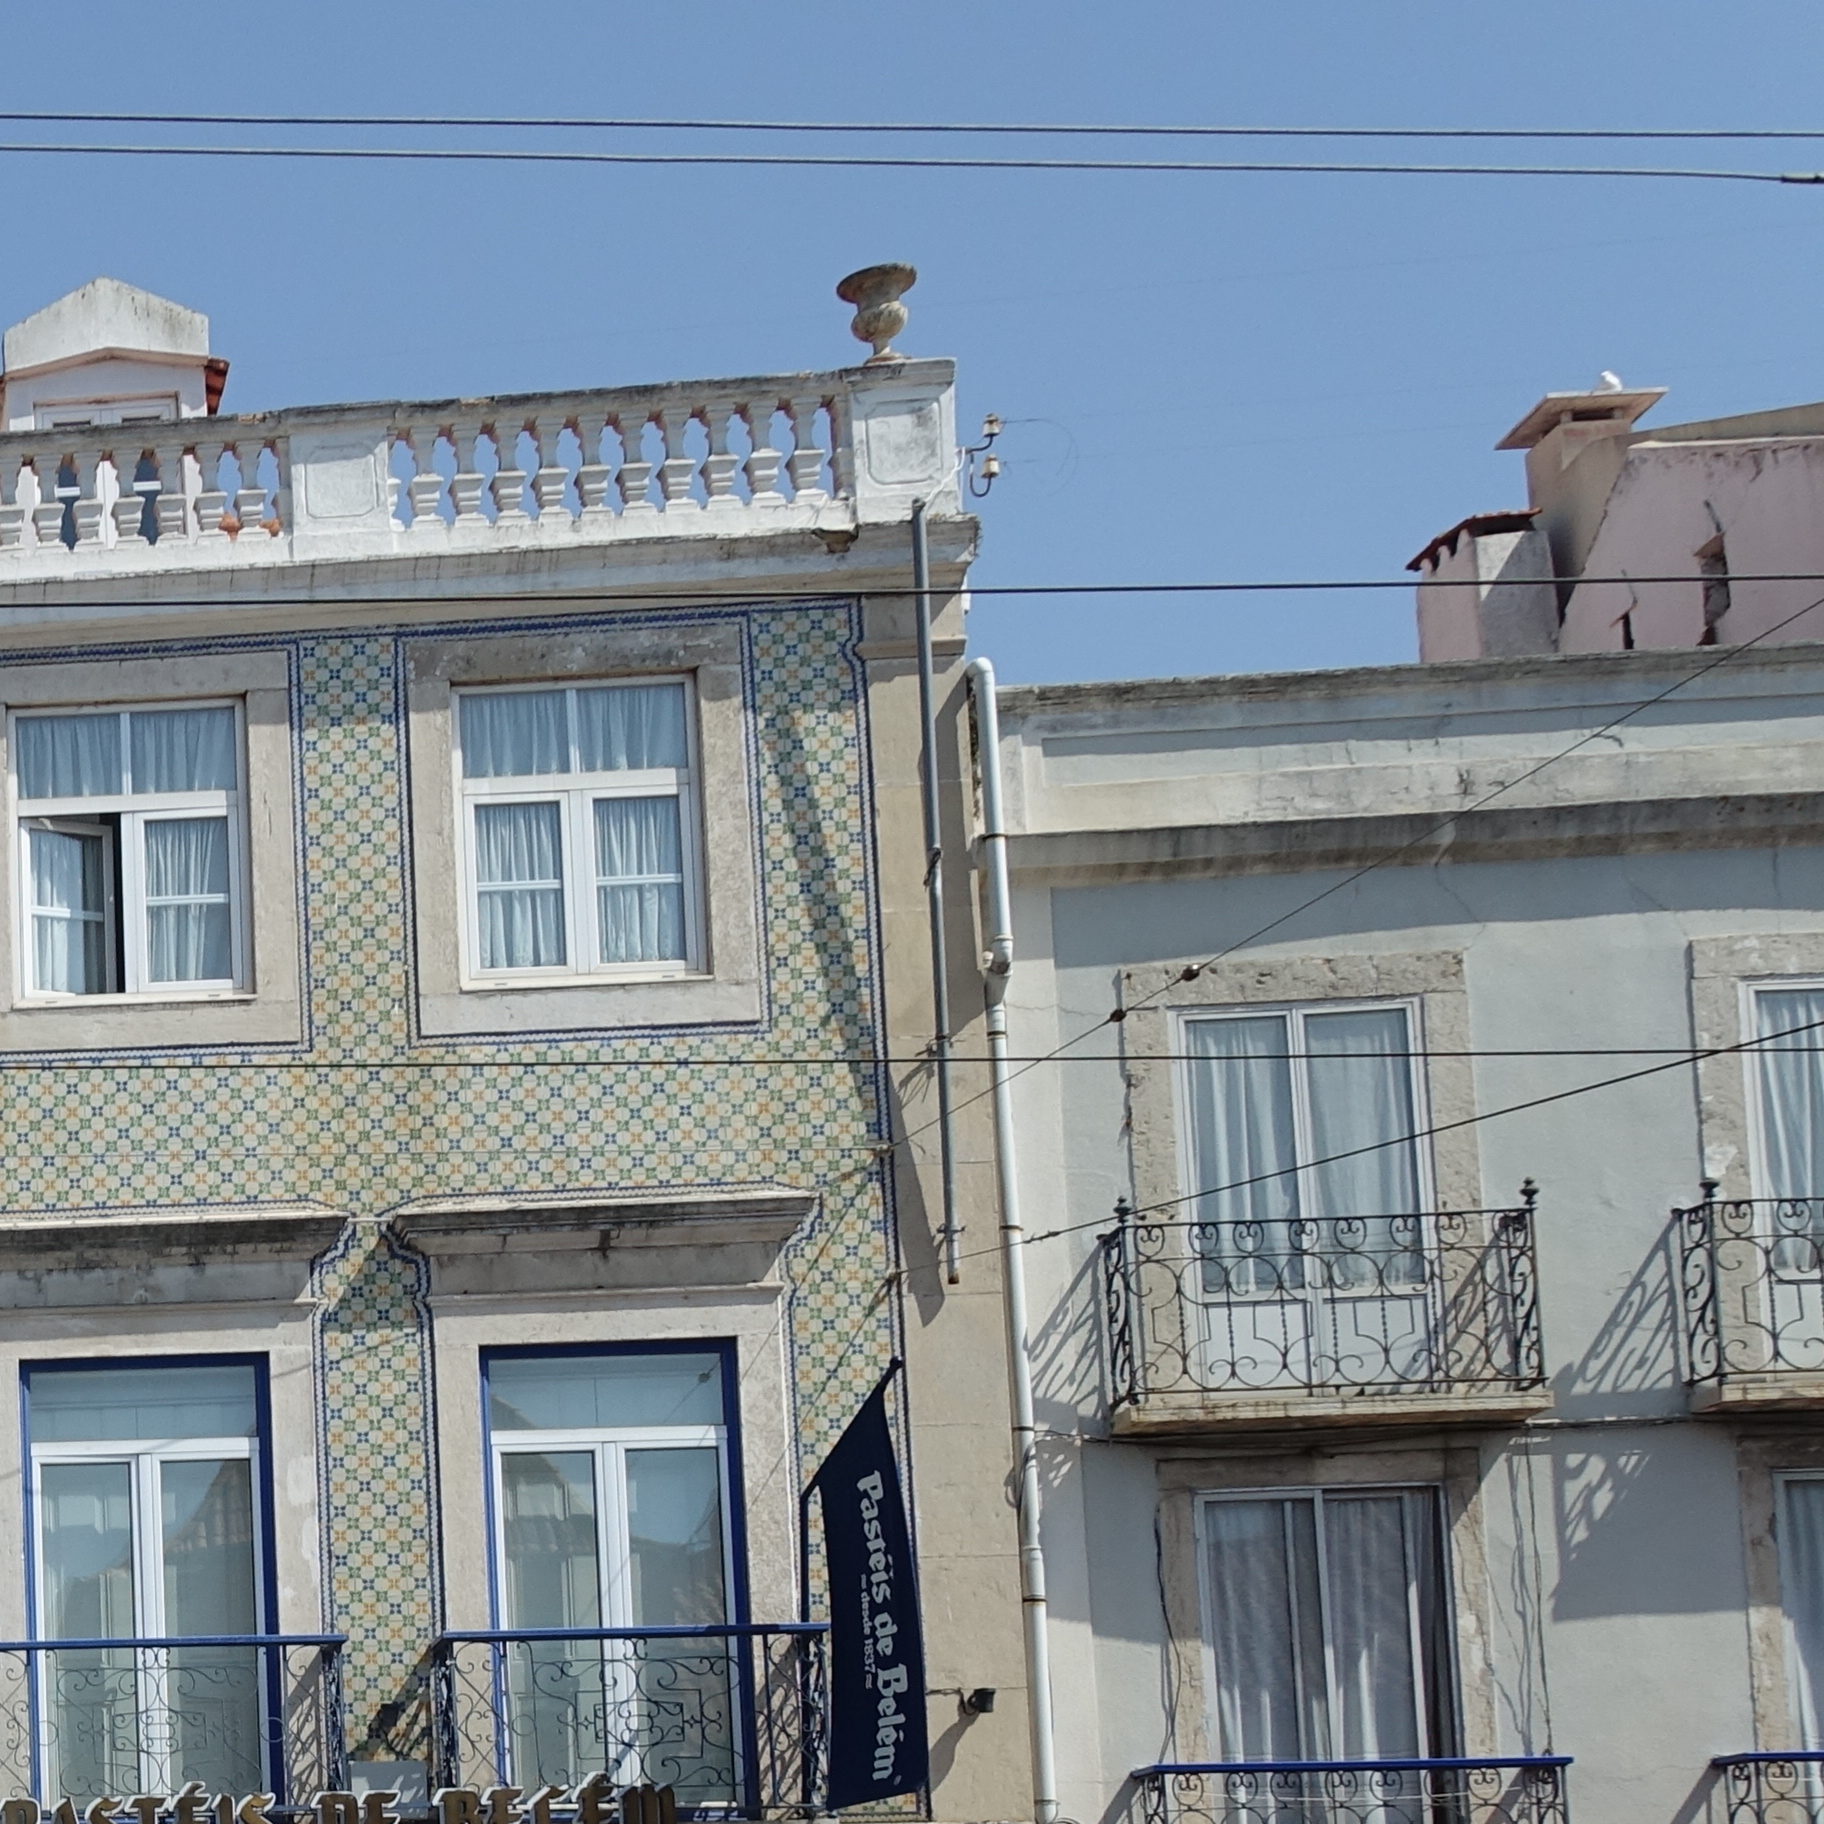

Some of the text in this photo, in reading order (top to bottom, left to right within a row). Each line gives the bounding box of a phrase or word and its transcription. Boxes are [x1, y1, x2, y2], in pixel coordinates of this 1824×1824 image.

[856, 1469, 909, 1782] Pastéis de Belém
[860, 1592, 876, 1673] desde 1837
